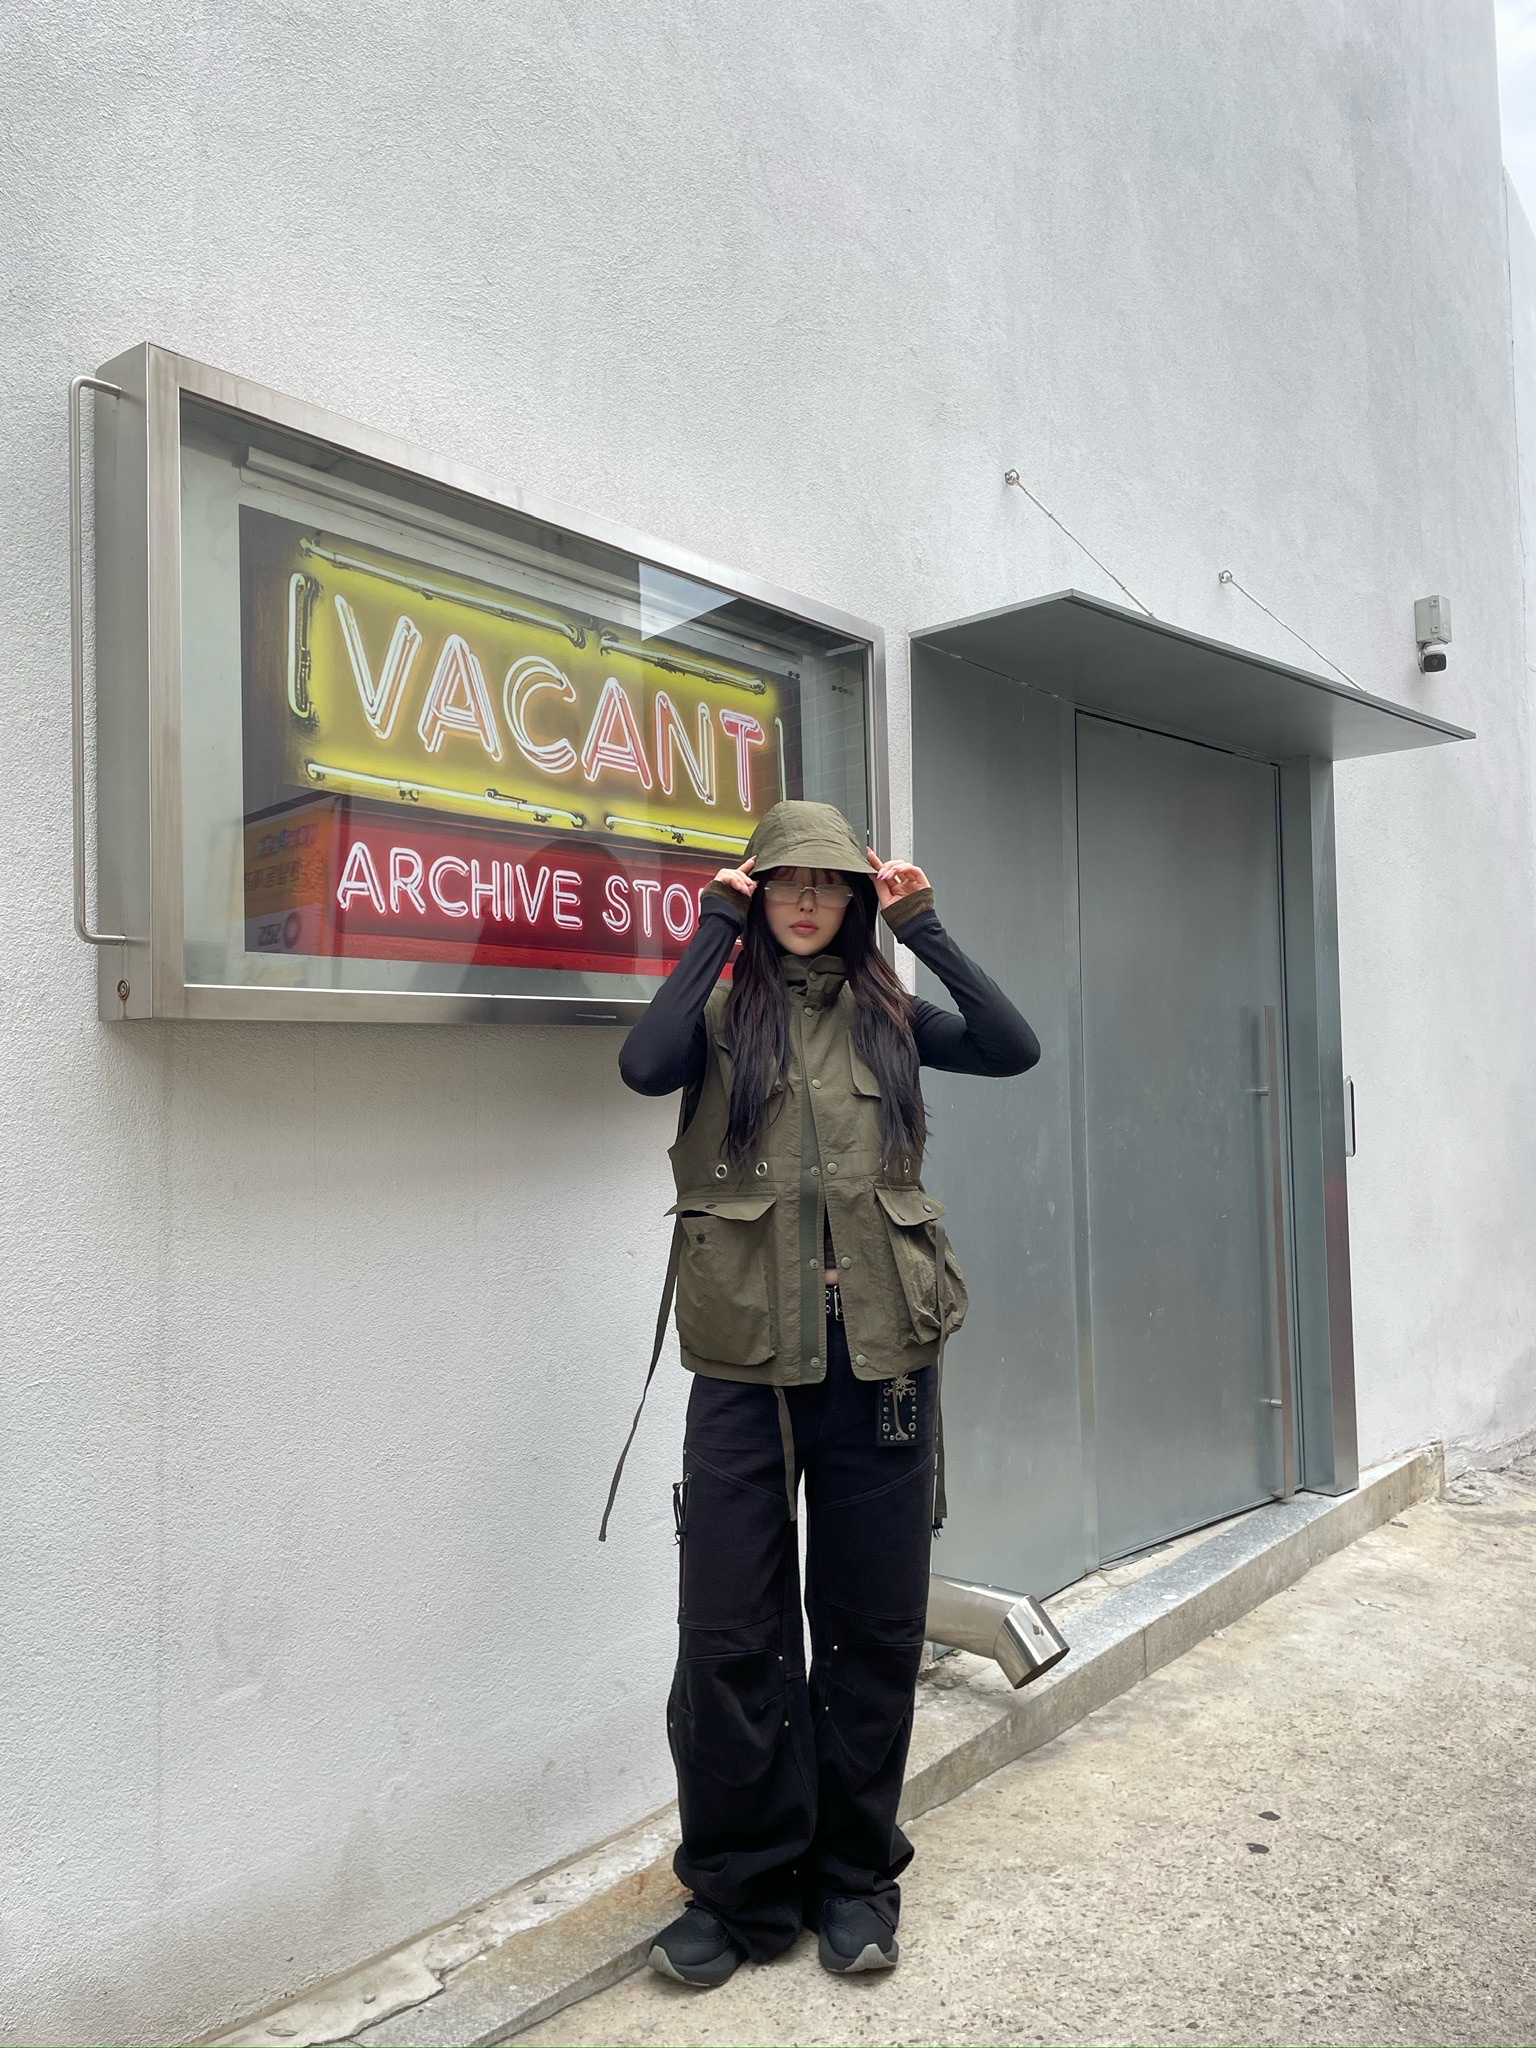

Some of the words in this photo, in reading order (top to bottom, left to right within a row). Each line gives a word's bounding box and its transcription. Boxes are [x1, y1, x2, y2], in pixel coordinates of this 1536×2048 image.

[335, 595, 765, 811] VACANT
[337, 841, 583, 930] ARCHIVE
[602, 874, 705, 942] STO
